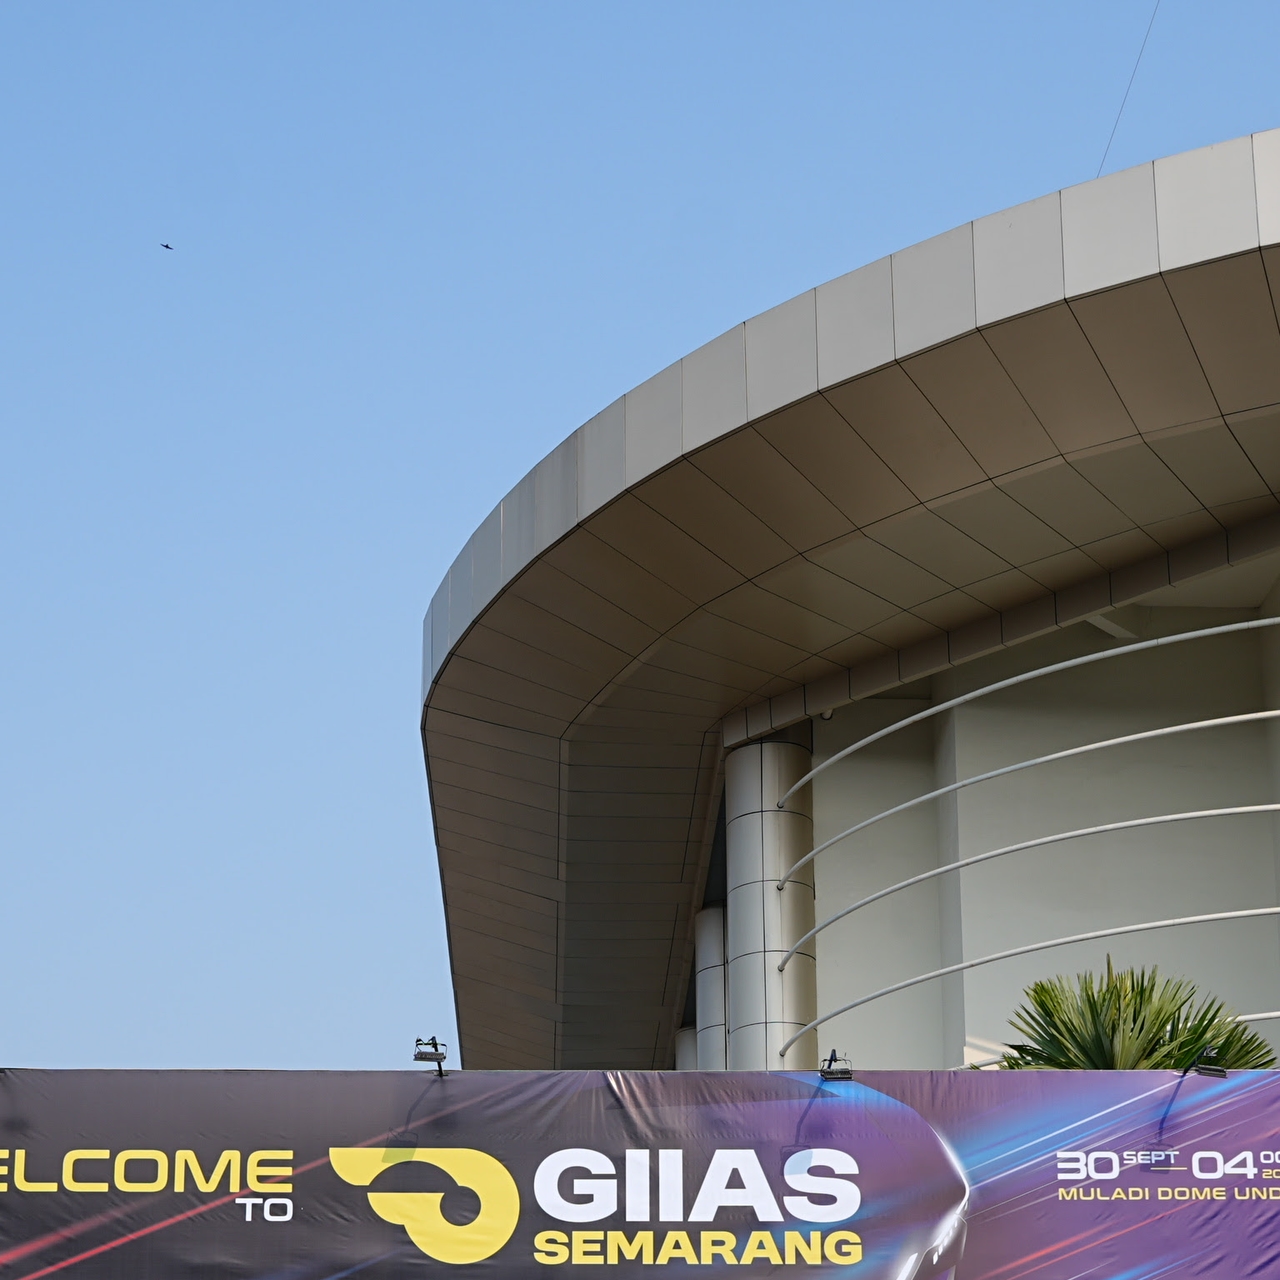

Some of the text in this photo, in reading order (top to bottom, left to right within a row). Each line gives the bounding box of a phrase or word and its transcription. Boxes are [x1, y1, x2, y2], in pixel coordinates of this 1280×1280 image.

[1056, 1151, 1120, 1180] 30
[1123, 1151, 1180, 1164] SEPT
[1192, 1151, 1258, 1180] 04
[533, 1148, 861, 1223] GIIAS
[1058, 1187, 1150, 1201] MULADI
[1158, 1187, 1226, 1200] DOME
[235, 1198, 293, 1222] TO
[533, 1230, 863, 1265] SEMARANG
